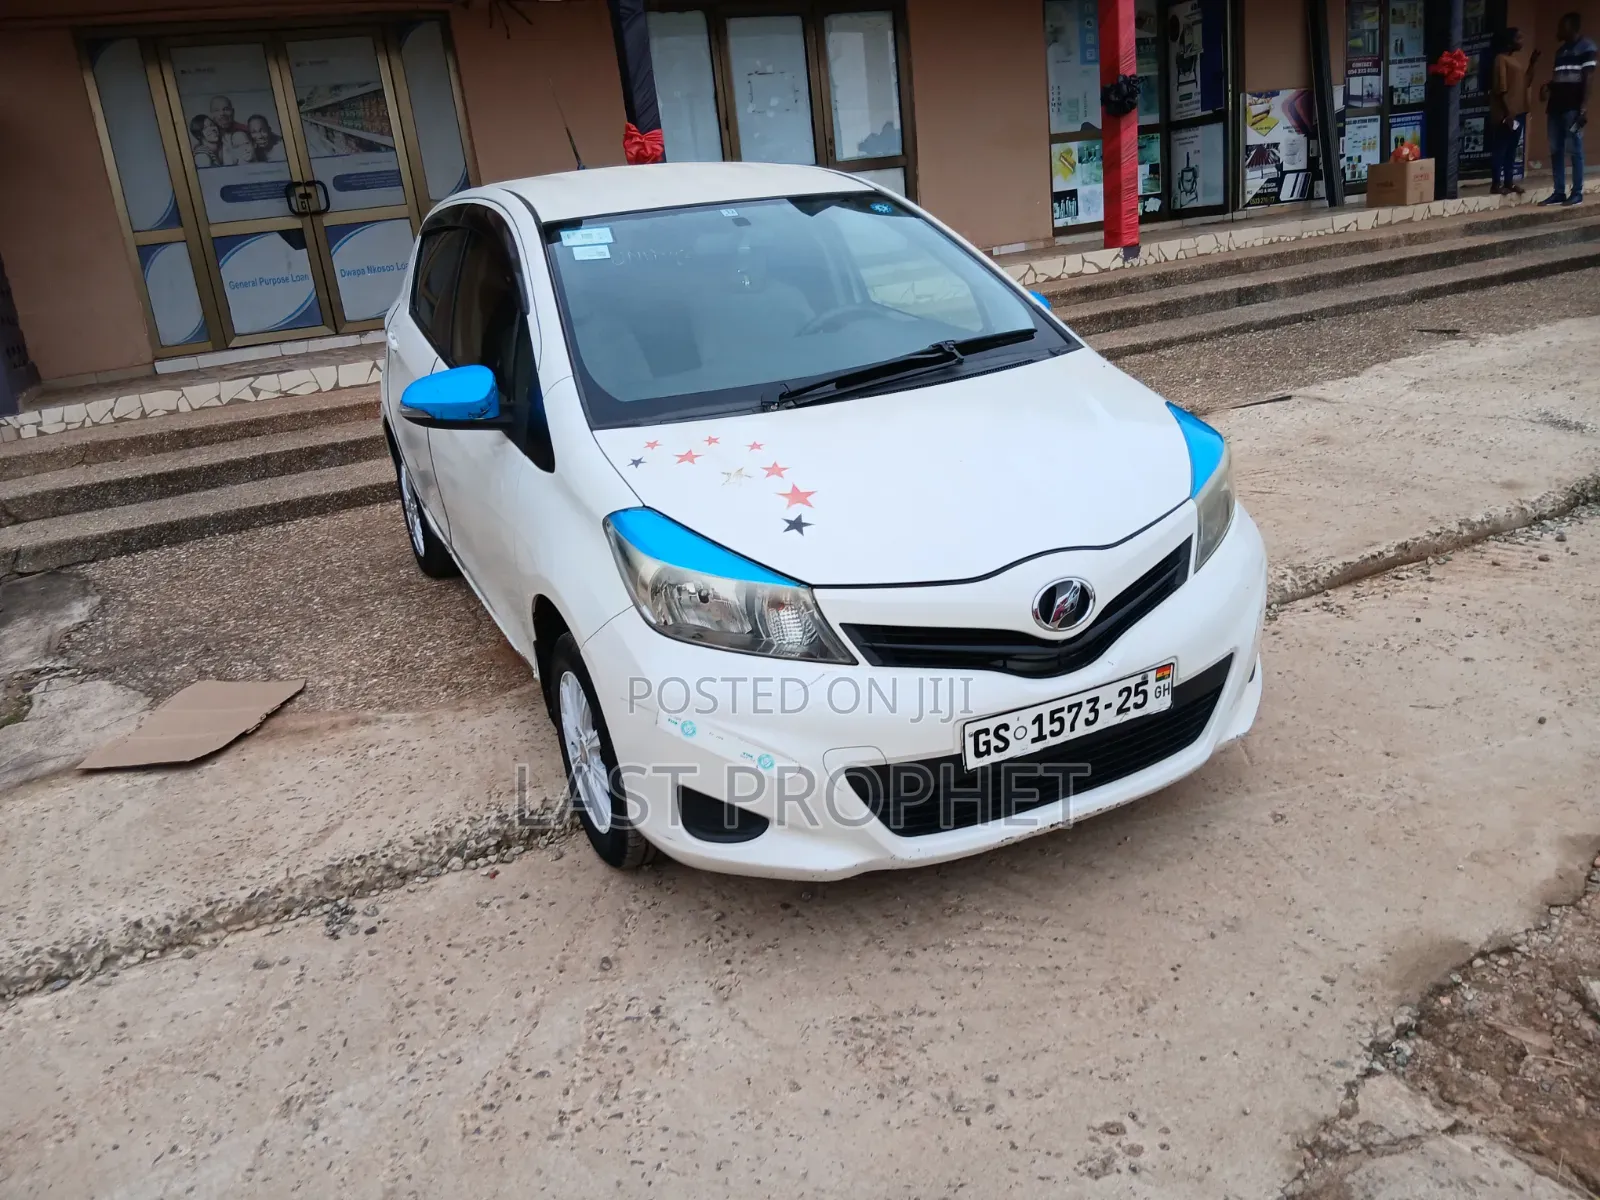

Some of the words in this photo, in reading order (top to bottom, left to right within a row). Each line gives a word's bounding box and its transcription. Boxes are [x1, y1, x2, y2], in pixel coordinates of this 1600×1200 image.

[228, 277, 258, 290] General
[259, 275, 290, 287] Purpose
[290, 272, 310, 283] Loan
[340, 268, 366, 279] Dwapa
[1154, 685, 1171, 699] GH
[973, 723, 1010, 759] GS
